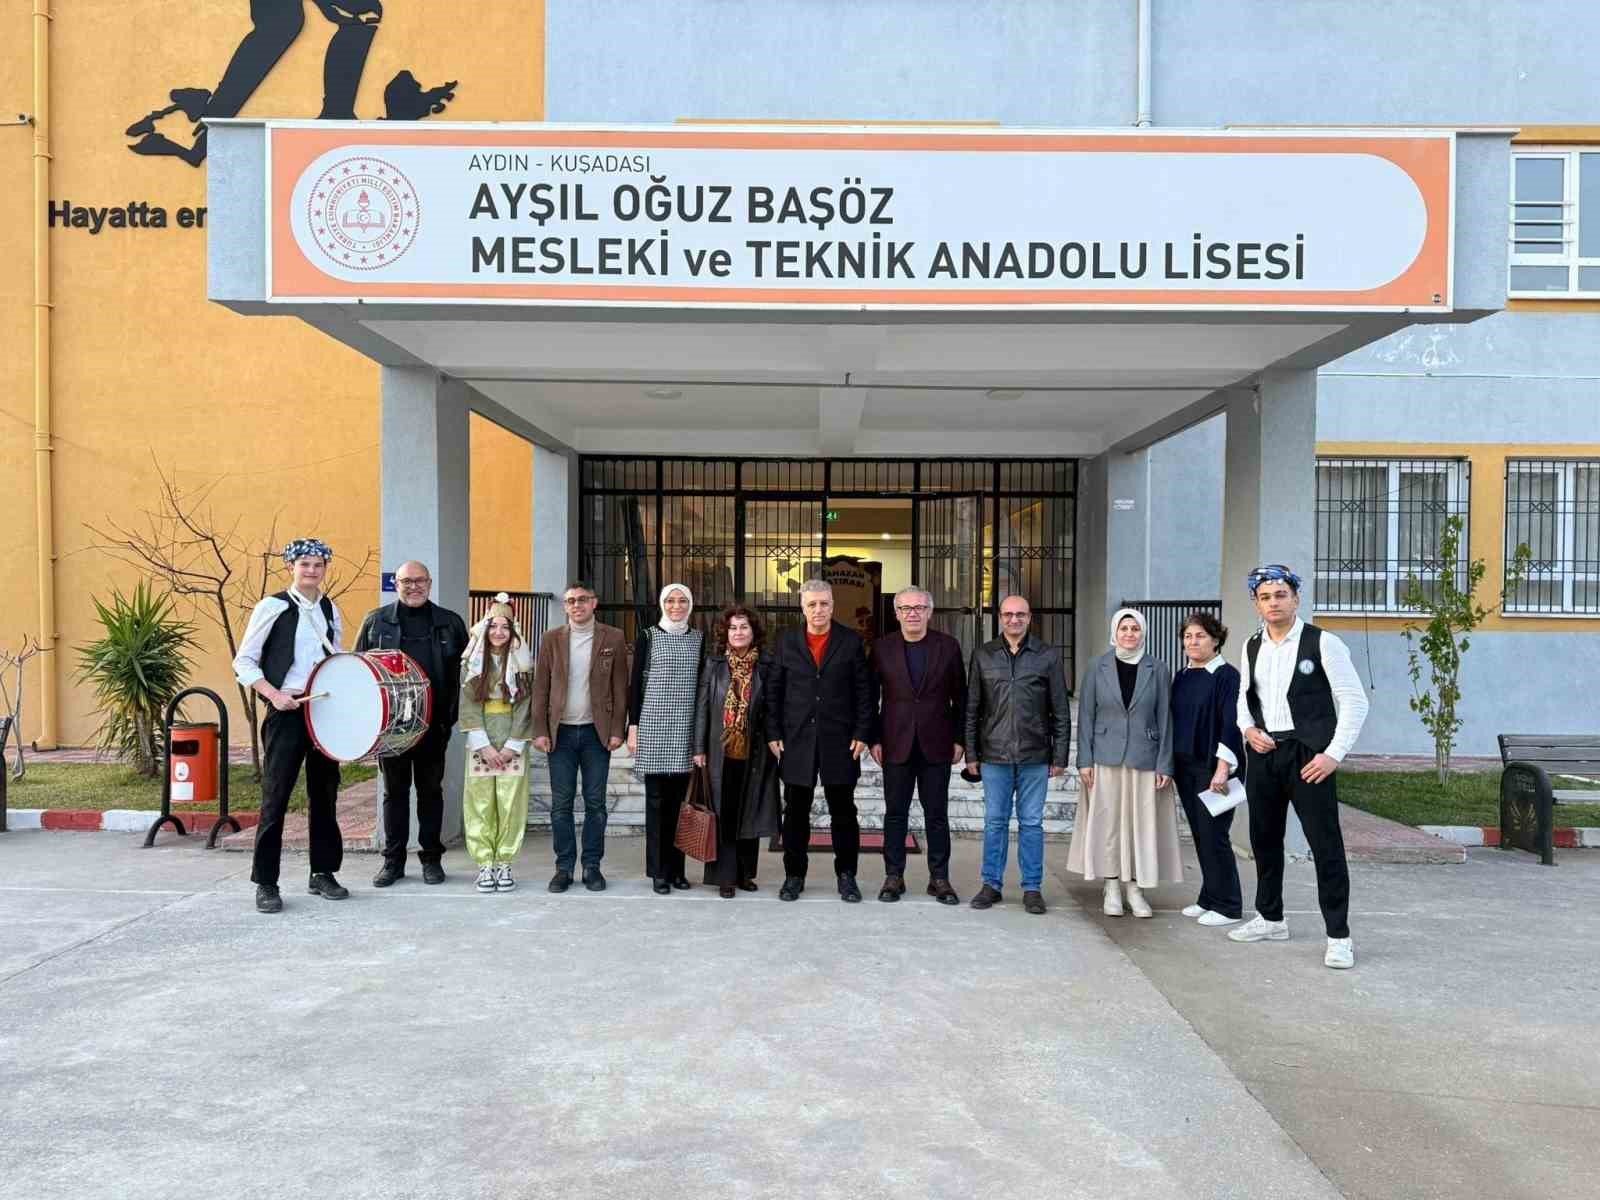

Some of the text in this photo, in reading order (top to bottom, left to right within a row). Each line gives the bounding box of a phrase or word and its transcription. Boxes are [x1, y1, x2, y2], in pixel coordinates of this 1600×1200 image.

[469, 154, 528, 172] AYDIN
[551, 155, 650, 174] KUŞADASI
[48, 200, 167, 234] Hayatta
[469, 175, 894, 230] AYŞIL OĞUZ BAŞÖZ
[472, 229, 1304, 281] MESLEKİ ve TEKNİK ANADOLU LİSESİ
